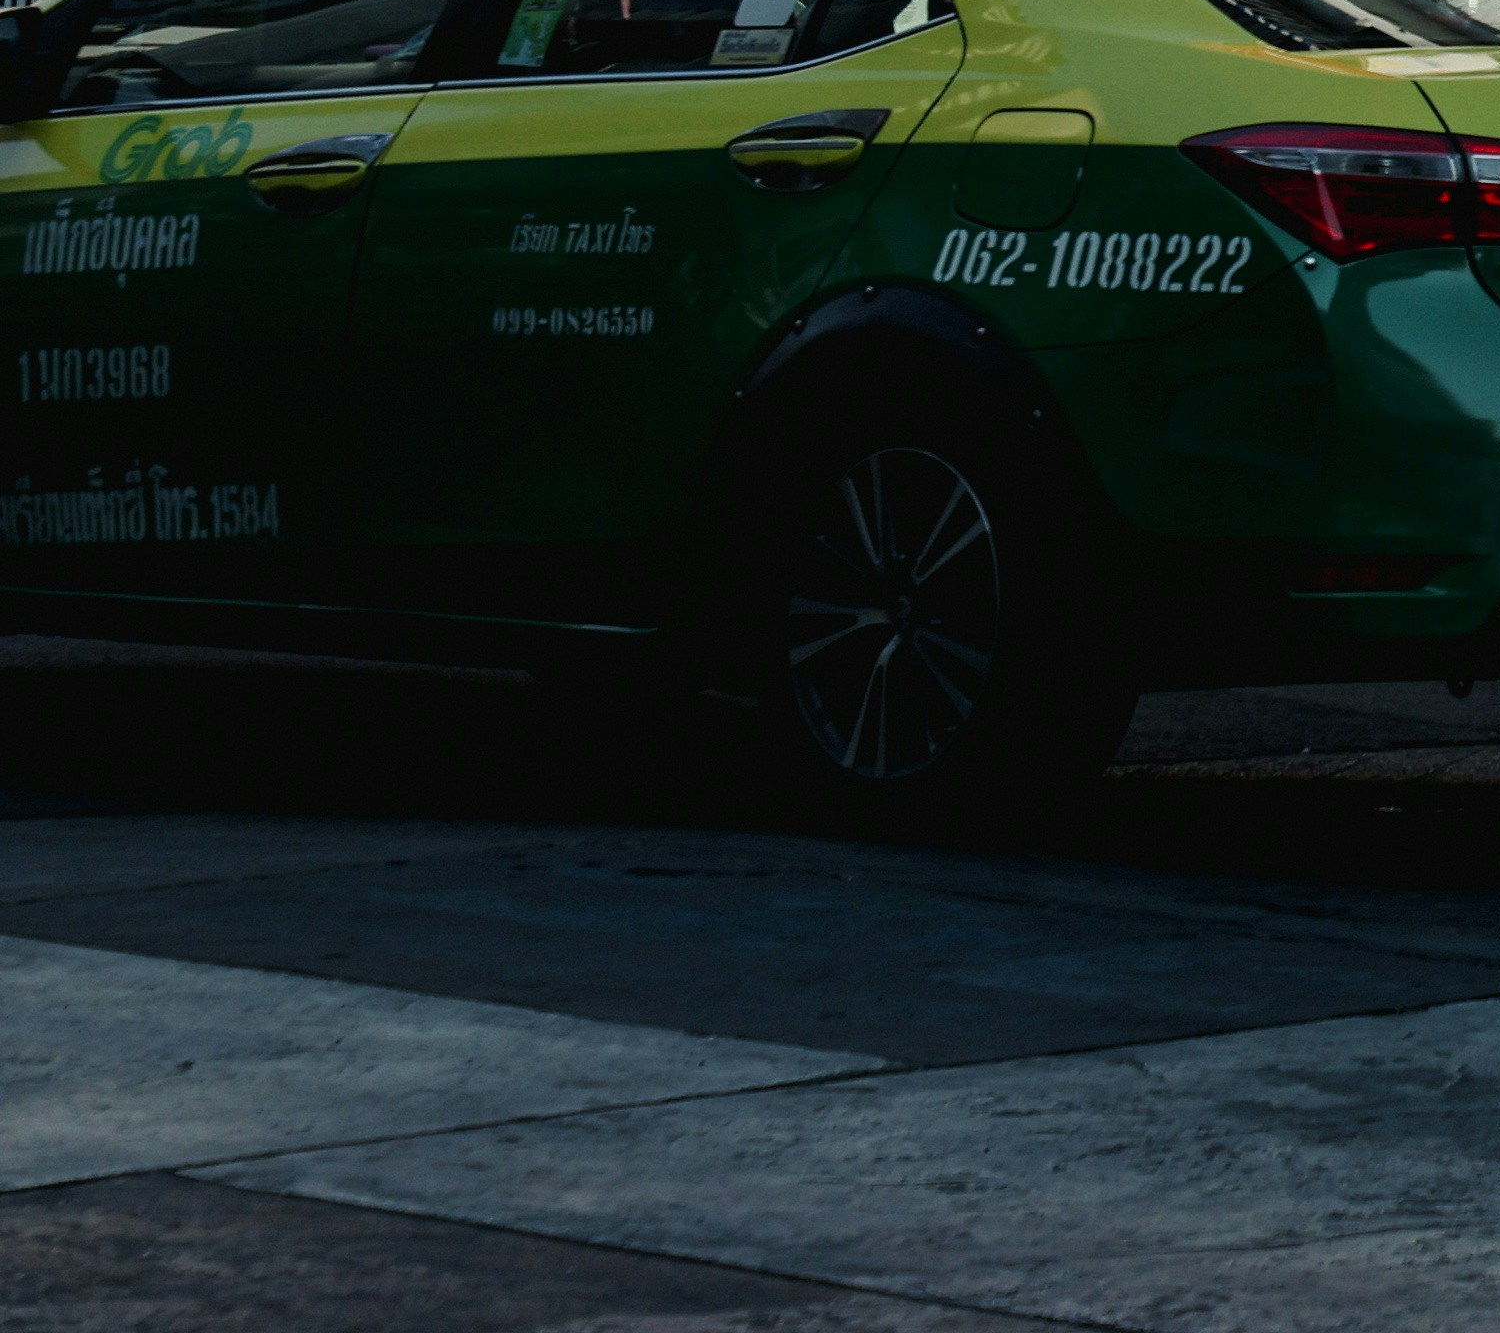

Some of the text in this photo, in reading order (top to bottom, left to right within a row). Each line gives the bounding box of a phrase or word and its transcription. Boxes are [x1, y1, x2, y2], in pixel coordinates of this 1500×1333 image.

[101, 107, 254, 185] Grab
[565, 223, 616, 253] TAXI
[933, 228, 1253, 294] 062-1088222
